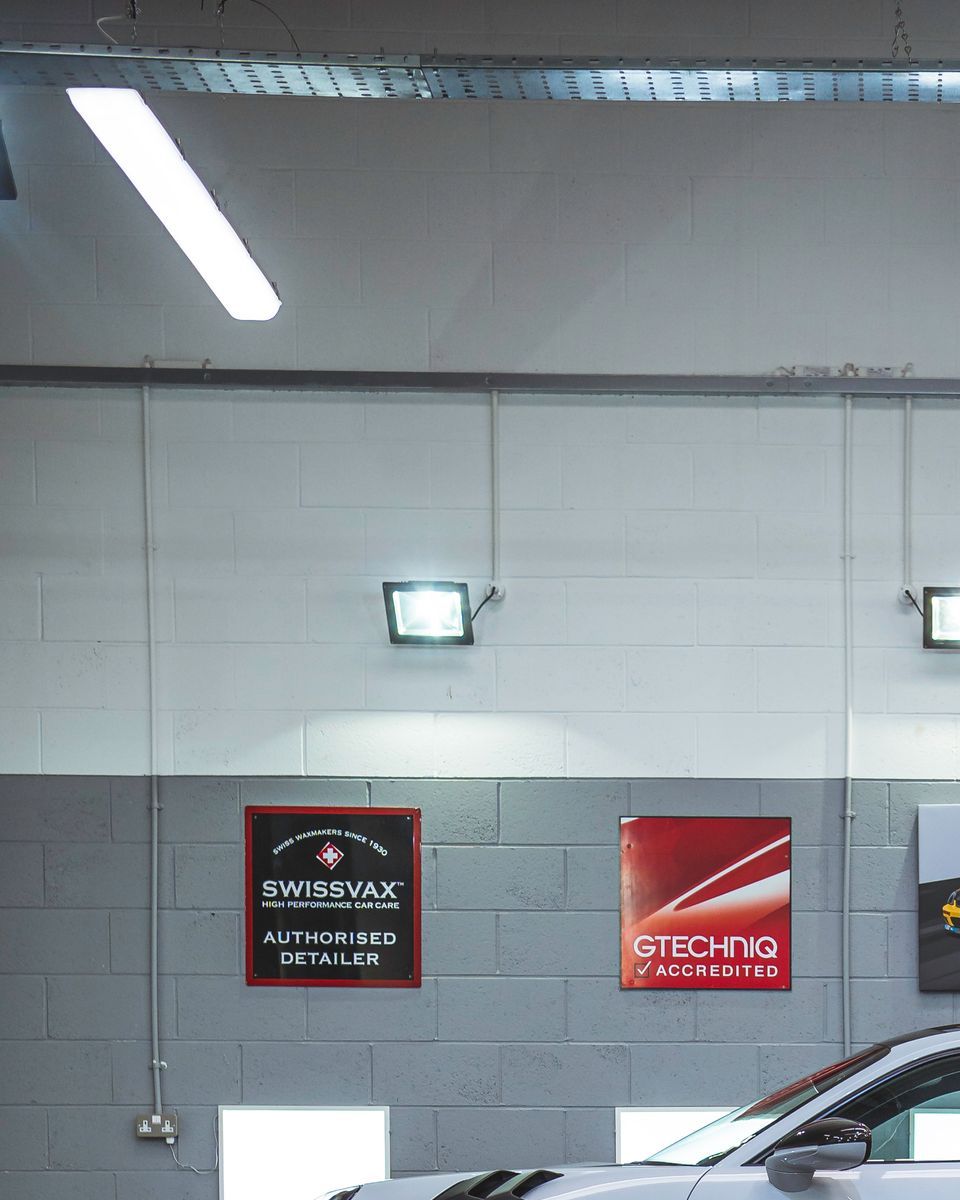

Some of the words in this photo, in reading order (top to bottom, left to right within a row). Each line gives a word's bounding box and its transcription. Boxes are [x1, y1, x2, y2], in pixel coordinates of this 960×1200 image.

[273, 838, 294, 855] SWISS
[295, 829, 342, 841] WAXMAKERS
[344, 831, 367, 844] SINCE
[369, 840, 388, 857] 1930
[287, 901, 352, 909] PERFORMANCE
[263, 931, 397, 945] AUTHORISED
[633, 934, 778, 959] GTECHNIQ
[281, 952, 379, 966] DETAILER
[656, 964, 778, 977] ACCREDITED
